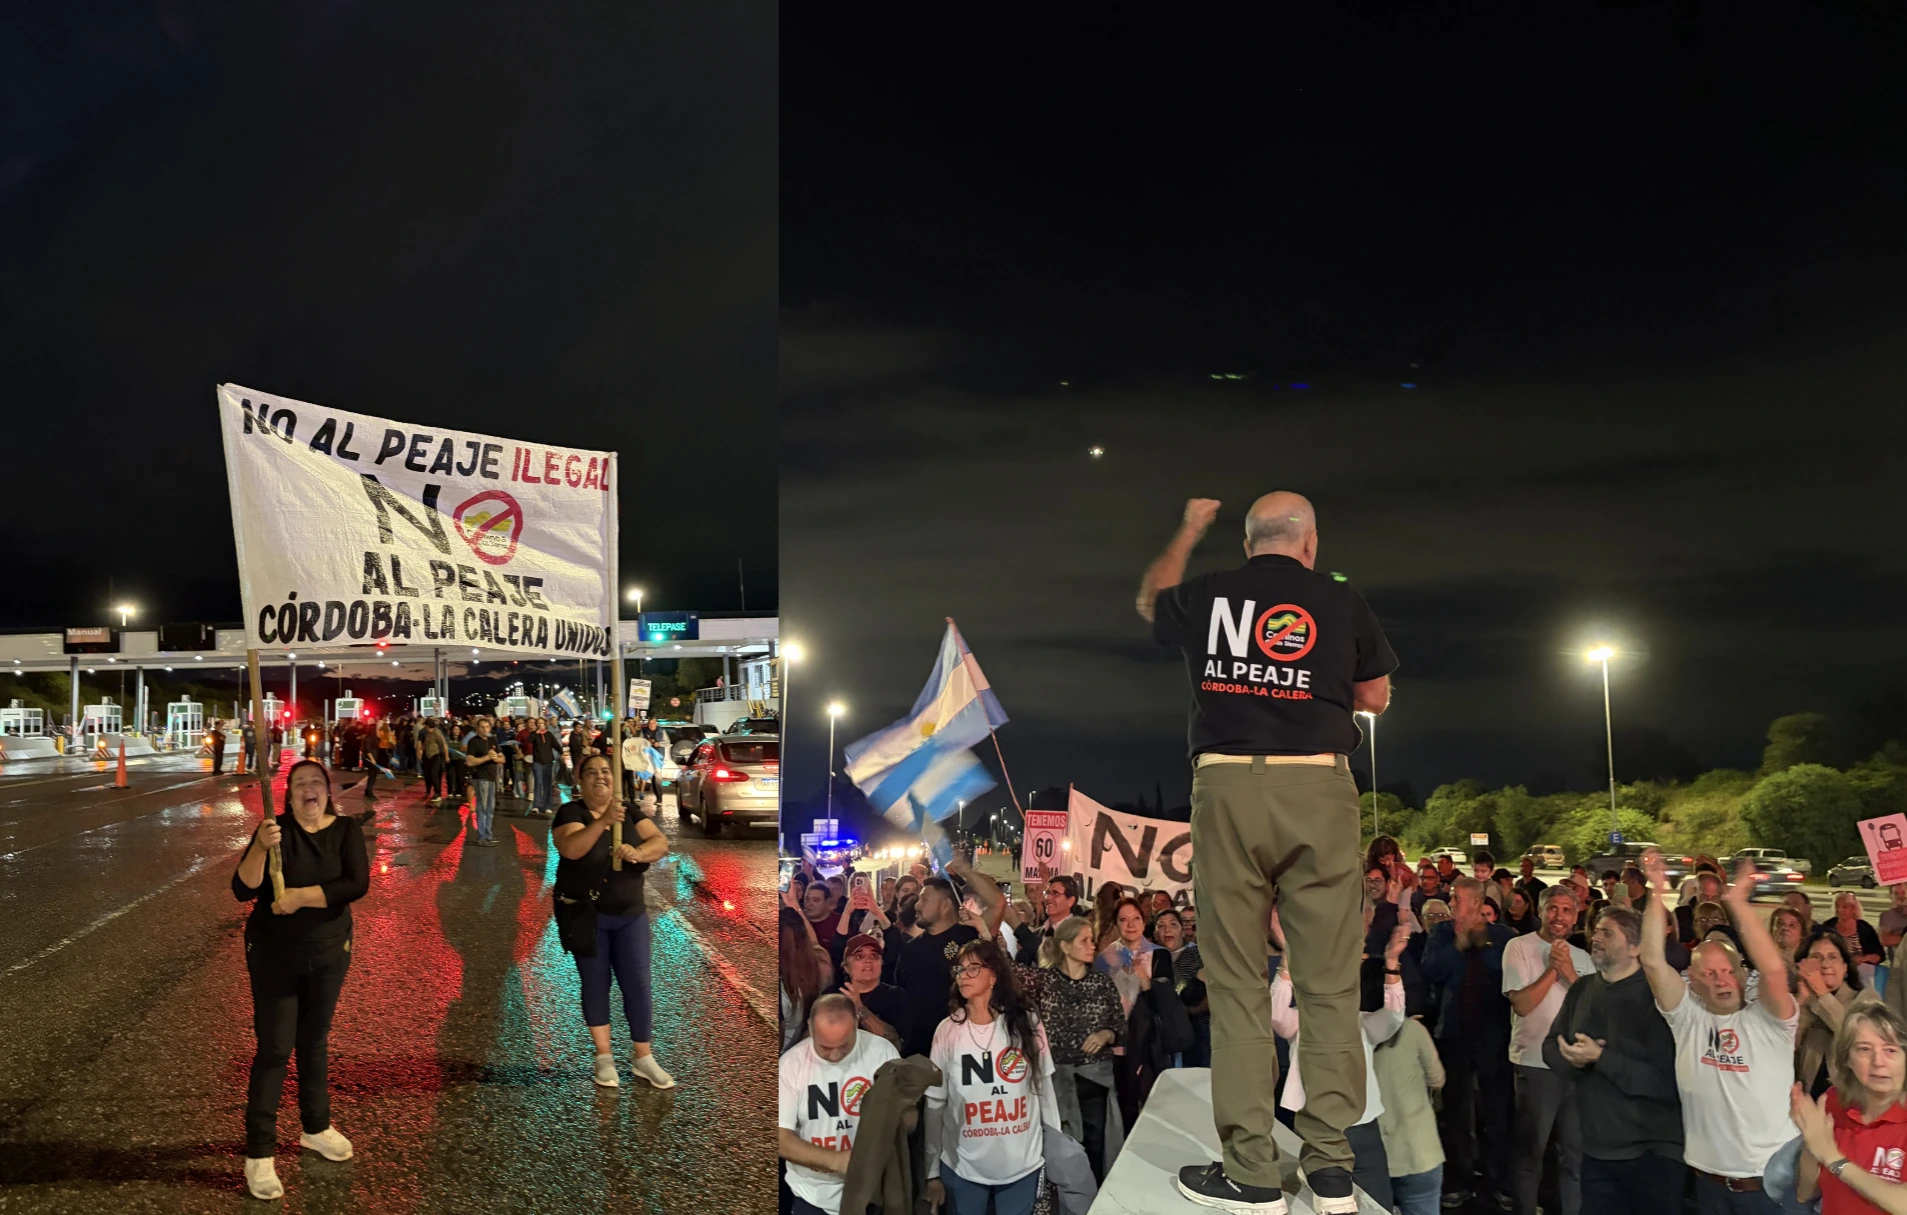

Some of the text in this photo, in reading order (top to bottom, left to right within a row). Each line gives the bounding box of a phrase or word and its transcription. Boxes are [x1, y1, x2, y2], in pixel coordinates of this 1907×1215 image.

[240, 398, 609, 491] NO AL PEAJE ILEGAL
[362, 551, 550, 611] AL PEAJE
[67, 628, 102, 636] Manual
[464, 606, 549, 650] CALERA
[648, 622, 686, 631] TELEPASE
[1204, 659, 1311, 689] AL PEAJE
[1271, 688, 1313, 699] CALERA
[1027, 814, 1066, 827] TENEMOS
[1613, 834, 1619, 843] E
[1035, 837, 1053, 858] 60
[991, 1085, 1008, 1096] AL
[965, 1095, 1027, 1125] PEAJE
[836, 1120, 853, 1130] AL
